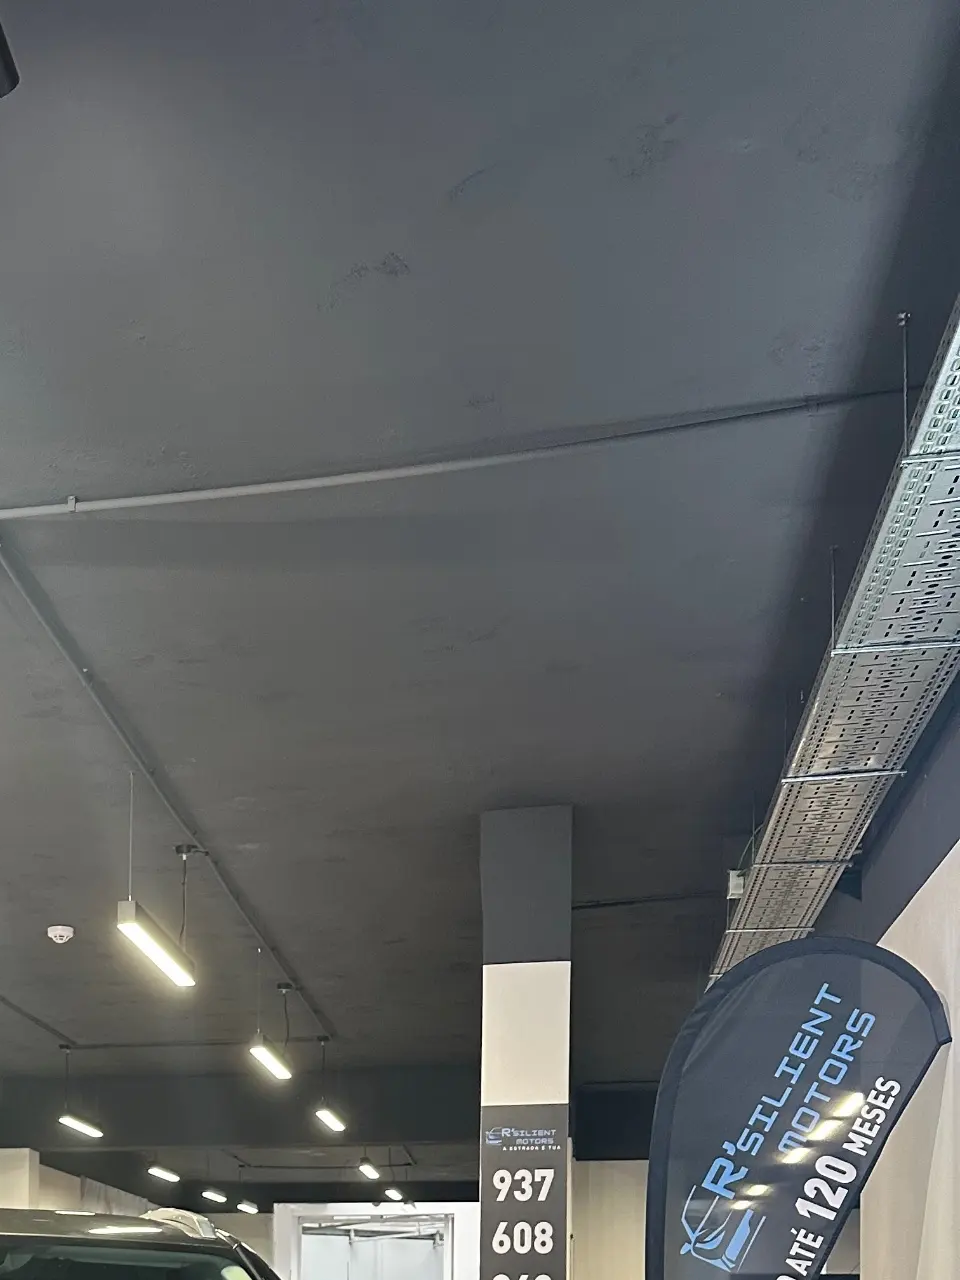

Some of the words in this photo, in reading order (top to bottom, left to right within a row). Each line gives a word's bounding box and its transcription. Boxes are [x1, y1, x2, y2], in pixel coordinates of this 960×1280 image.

[702, 982, 844, 1201] R'SILIENT
[778, 1007, 877, 1153] MOTORS
[515, 1137, 555, 1145] MOTORS
[841, 1076, 902, 1157] MESES
[492, 1169, 555, 1202] 937
[795, 1154, 859, 1223] 120
[491, 1221, 554, 1255] 608
[785, 1228, 824, 1279] ATÉ
